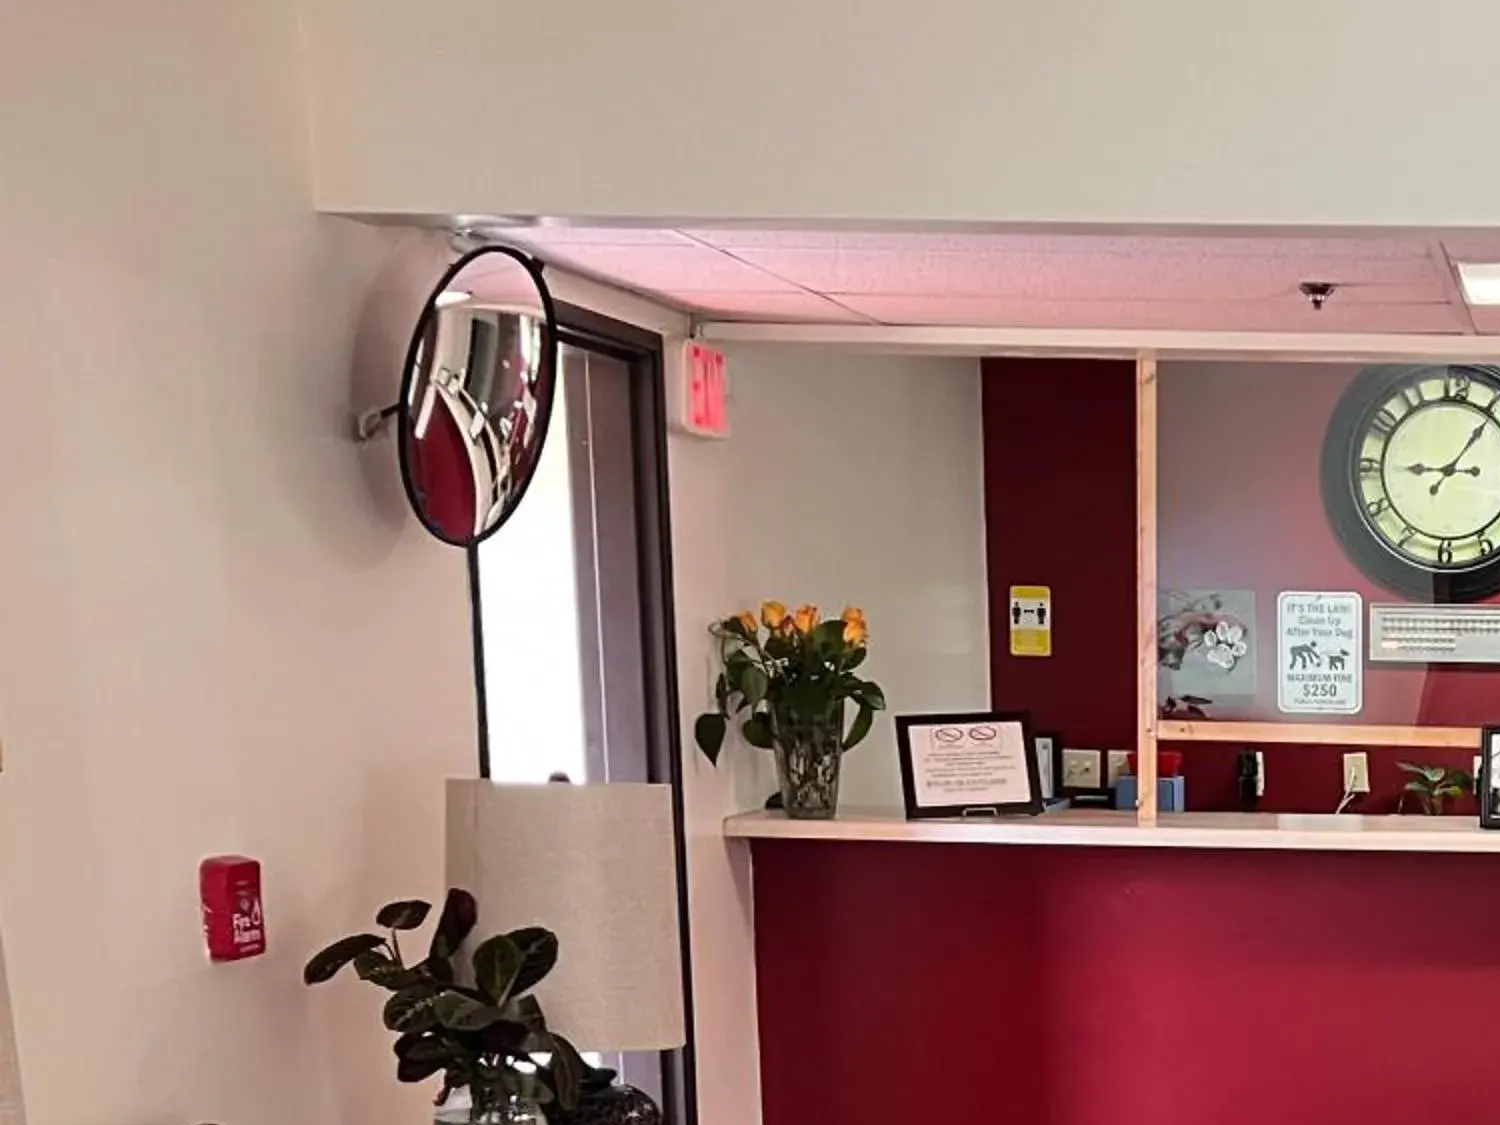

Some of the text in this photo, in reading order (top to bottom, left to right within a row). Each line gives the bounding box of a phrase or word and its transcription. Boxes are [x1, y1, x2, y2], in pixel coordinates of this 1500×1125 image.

[1443, 377, 1471, 401] 12
[1366, 497, 1390, 518] 8
[1437, 539, 1453, 564] 6
[1307, 603, 1325, 613] THE
[1327, 615, 1342, 626] Up
[1286, 627, 1354, 640] After Your Dog
[1302, 684, 1337, 697] $250
[232, 913, 251, 929] Fire
